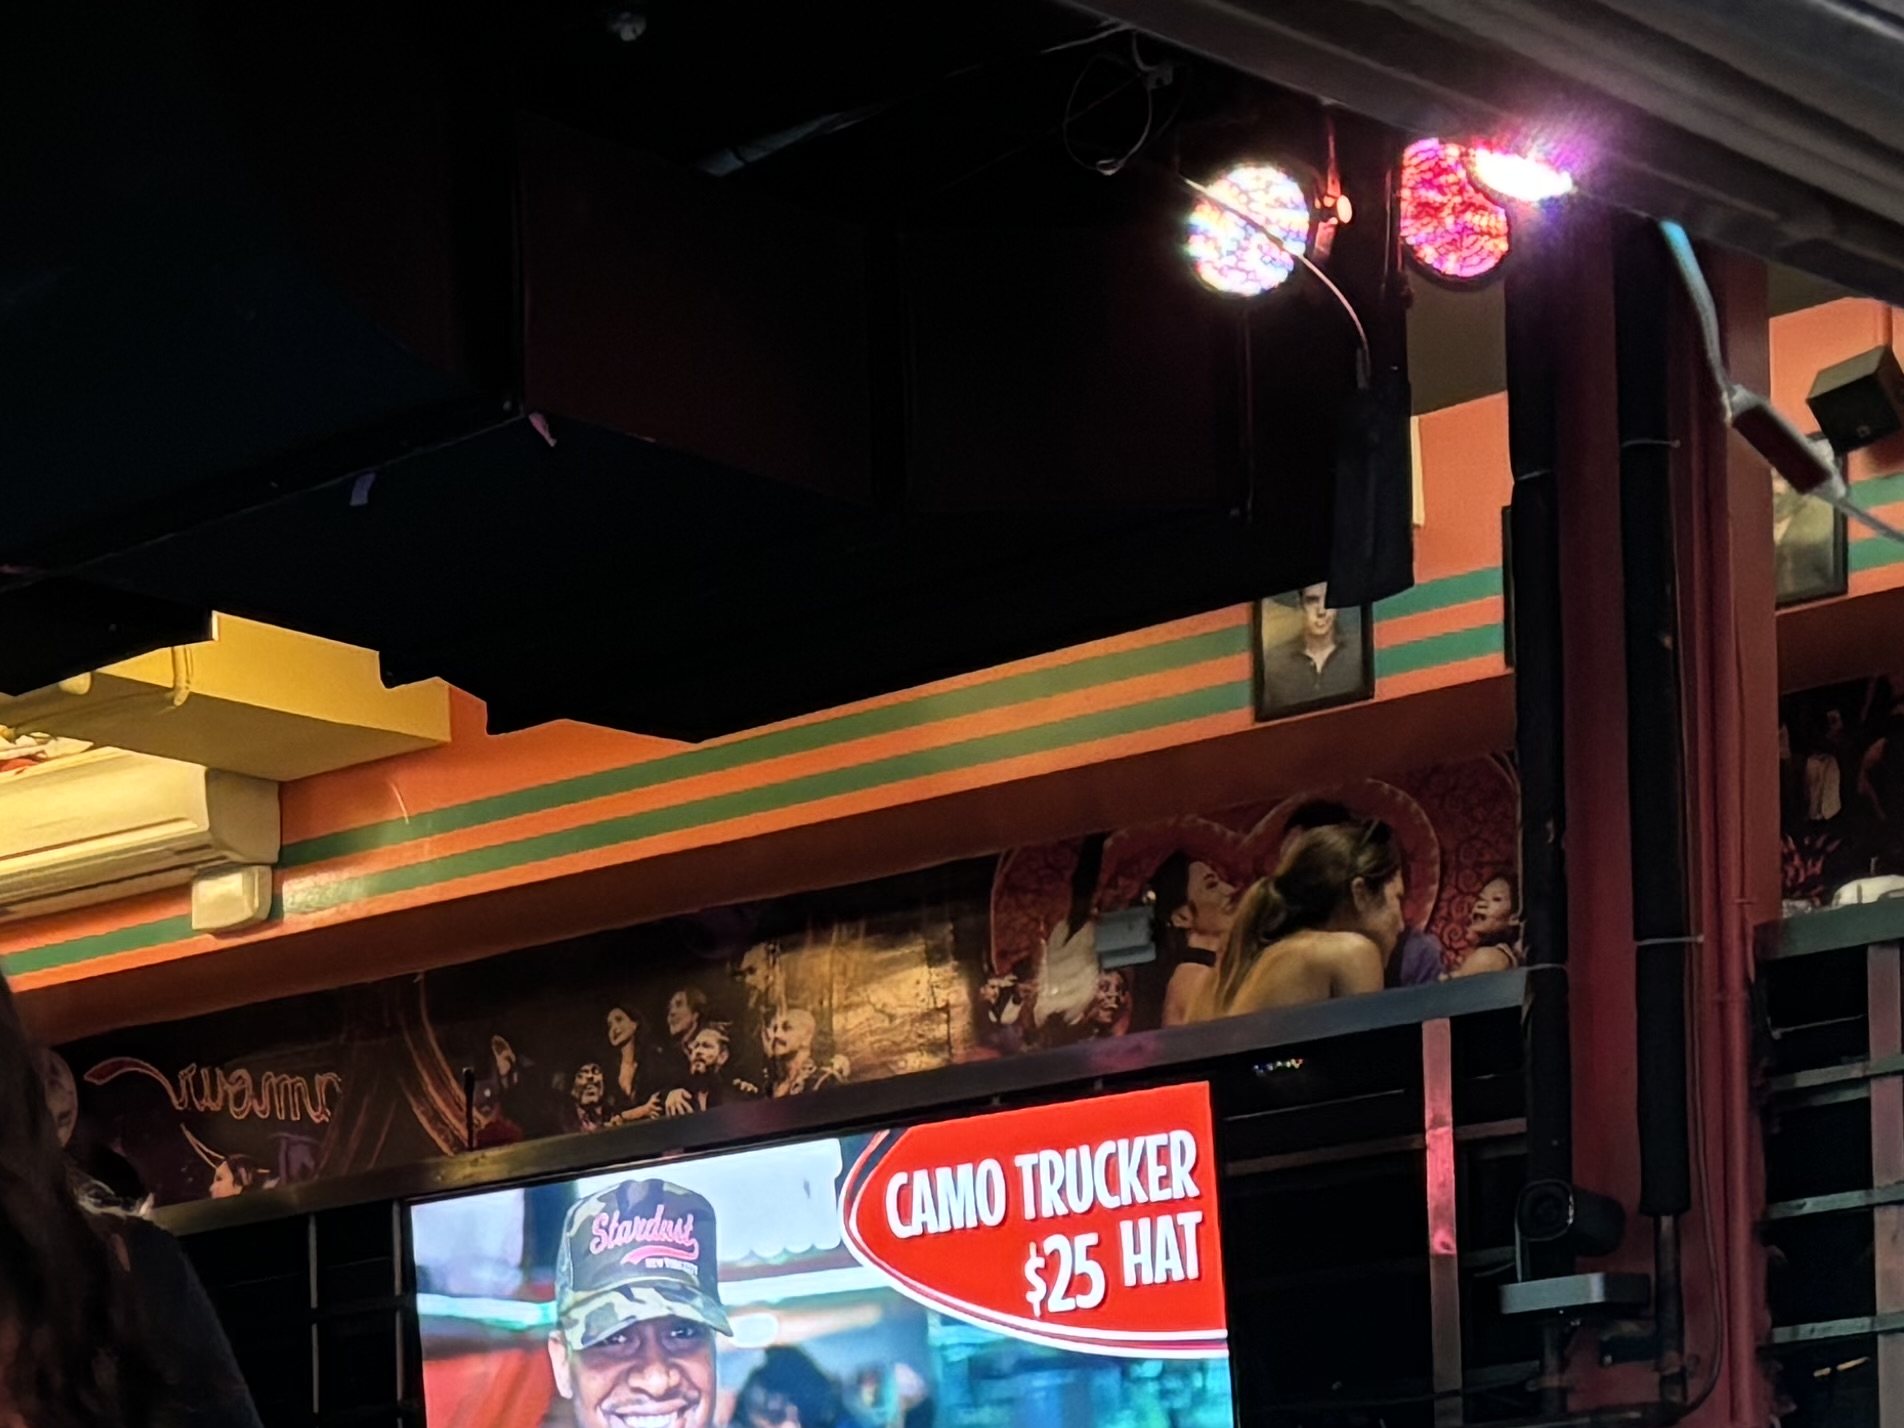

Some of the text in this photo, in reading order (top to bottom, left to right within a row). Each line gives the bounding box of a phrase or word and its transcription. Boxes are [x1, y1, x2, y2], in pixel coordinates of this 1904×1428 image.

[590, 1204, 699, 1255] Stardust
[885, 1129, 1200, 1239] CAMO TRUCKER
[1024, 1211, 1203, 1318] $25 HAT
